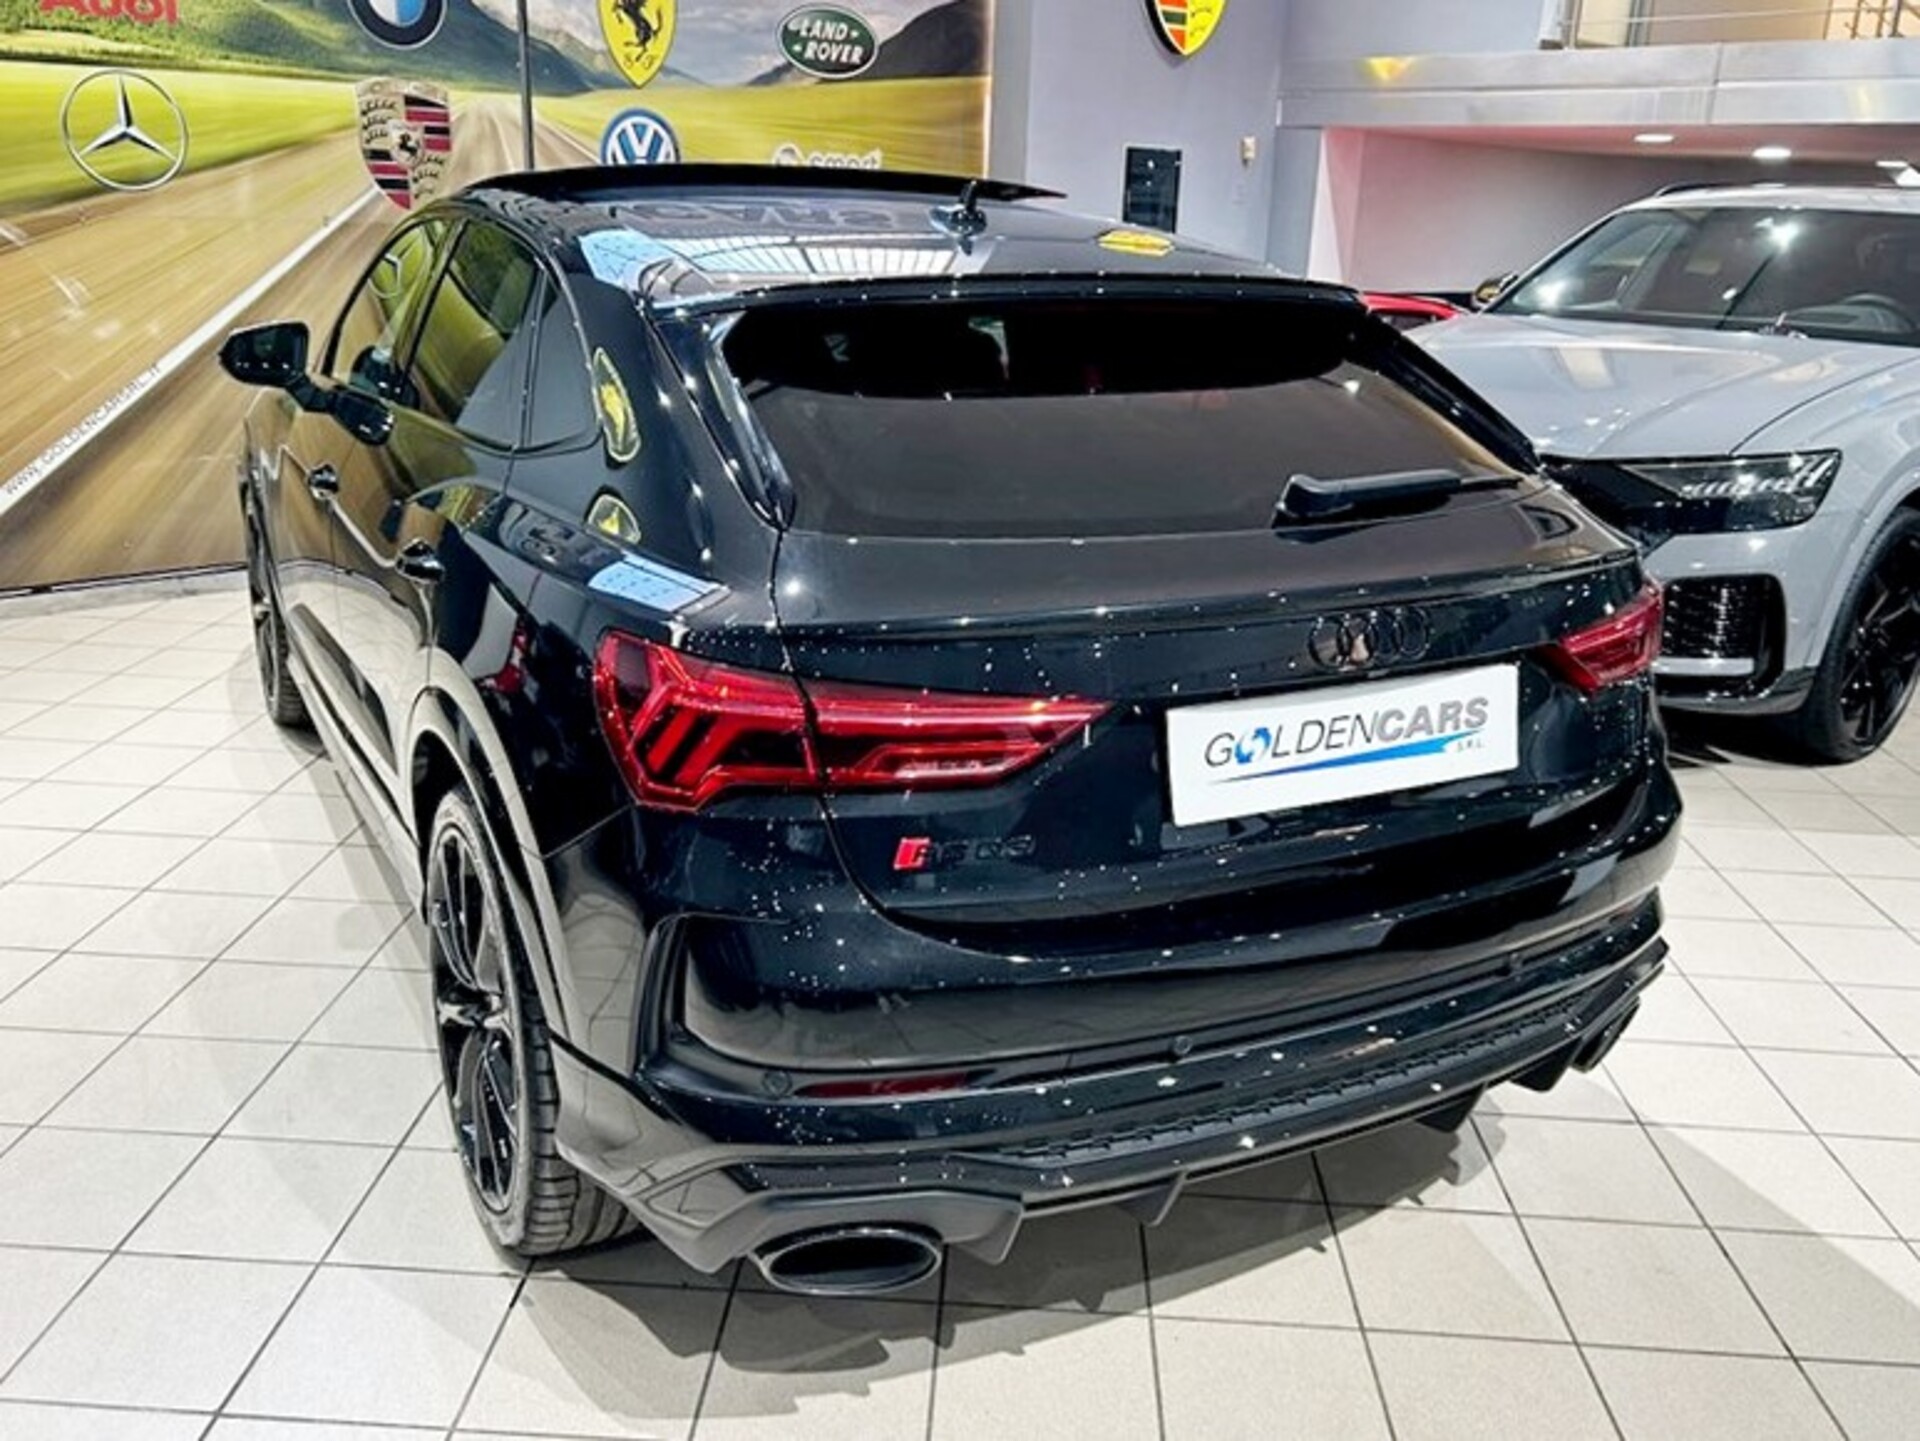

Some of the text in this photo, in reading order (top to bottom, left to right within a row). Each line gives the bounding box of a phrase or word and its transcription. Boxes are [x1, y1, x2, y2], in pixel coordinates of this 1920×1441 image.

[800, 18, 849, 41] LAND
[804, 41, 864, 64] ROVER
[1204, 697, 1489, 767] GOLDENCARS
